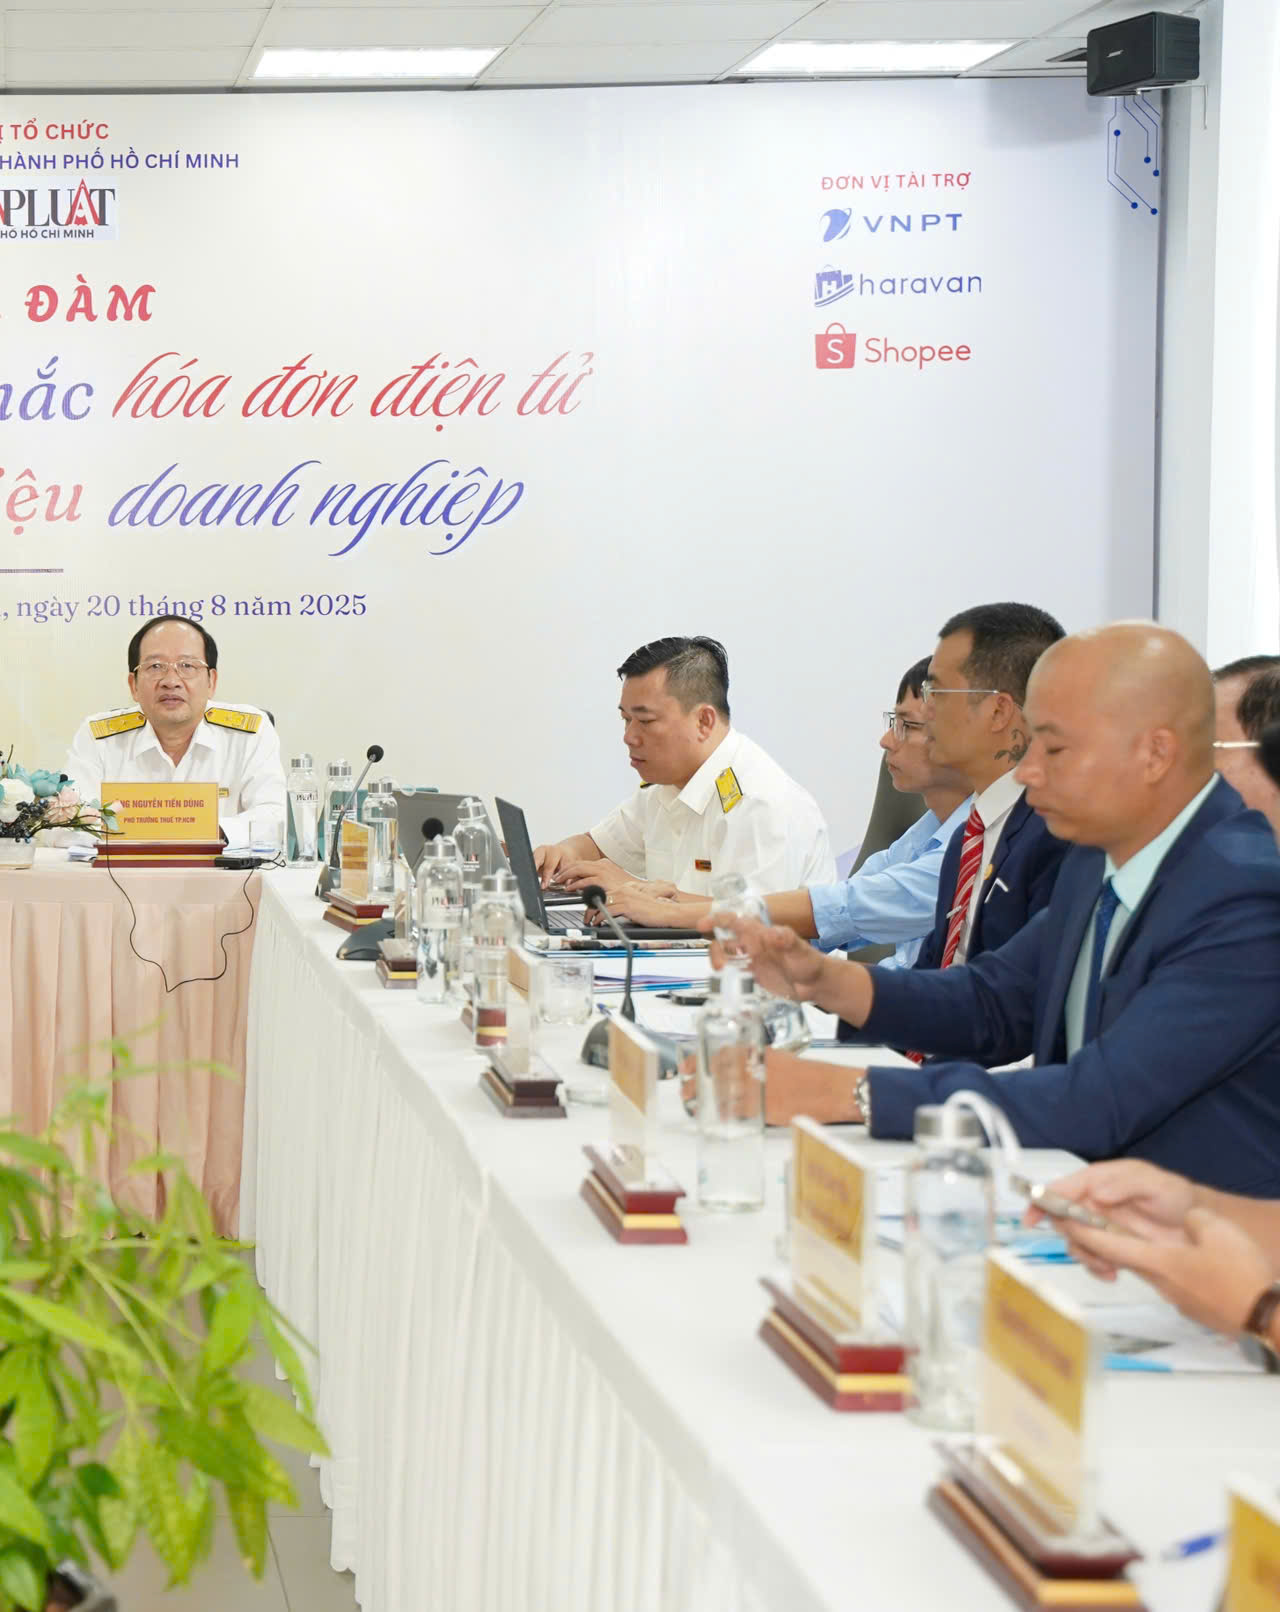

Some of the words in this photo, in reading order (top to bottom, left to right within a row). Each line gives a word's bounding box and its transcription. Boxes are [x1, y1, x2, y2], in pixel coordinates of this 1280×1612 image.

[9, 117, 39, 141] TỔ
[45, 119, 109, 141] CHỨC
[63, 146, 105, 169] PHỐ
[110, 146, 140, 169] HỒ
[145, 149, 180, 169] CHÍ
[186, 153, 239, 169] MINH
[821, 175, 865, 191] ĐƠN
[870, 174, 890, 193] VỊ
[895, 171, 926, 189] TÀI
[931, 171, 972, 191] TRỢ
[63, 228, 95, 239] MINH
[863, 213, 963, 233] VNPT
[859, 273, 982, 296] haravan
[23, 273, 157, 323] ĐÀM
[864, 337, 972, 370] Shopee
[111, 351, 233, 419] hóa
[241, 353, 359, 419] đơn
[369, 352, 506, 433] điện
[516, 351, 594, 417] tử
[107, 460, 321, 527] doanh
[308, 459, 525, 557] nghiệp
[16, 595, 80, 624] ngày
[87, 594, 121, 617] 20
[128, 594, 205, 622] tháng
[210, 594, 227, 617] 8
[233, 595, 292, 617] năm
[299, 594, 367, 617] 2025
